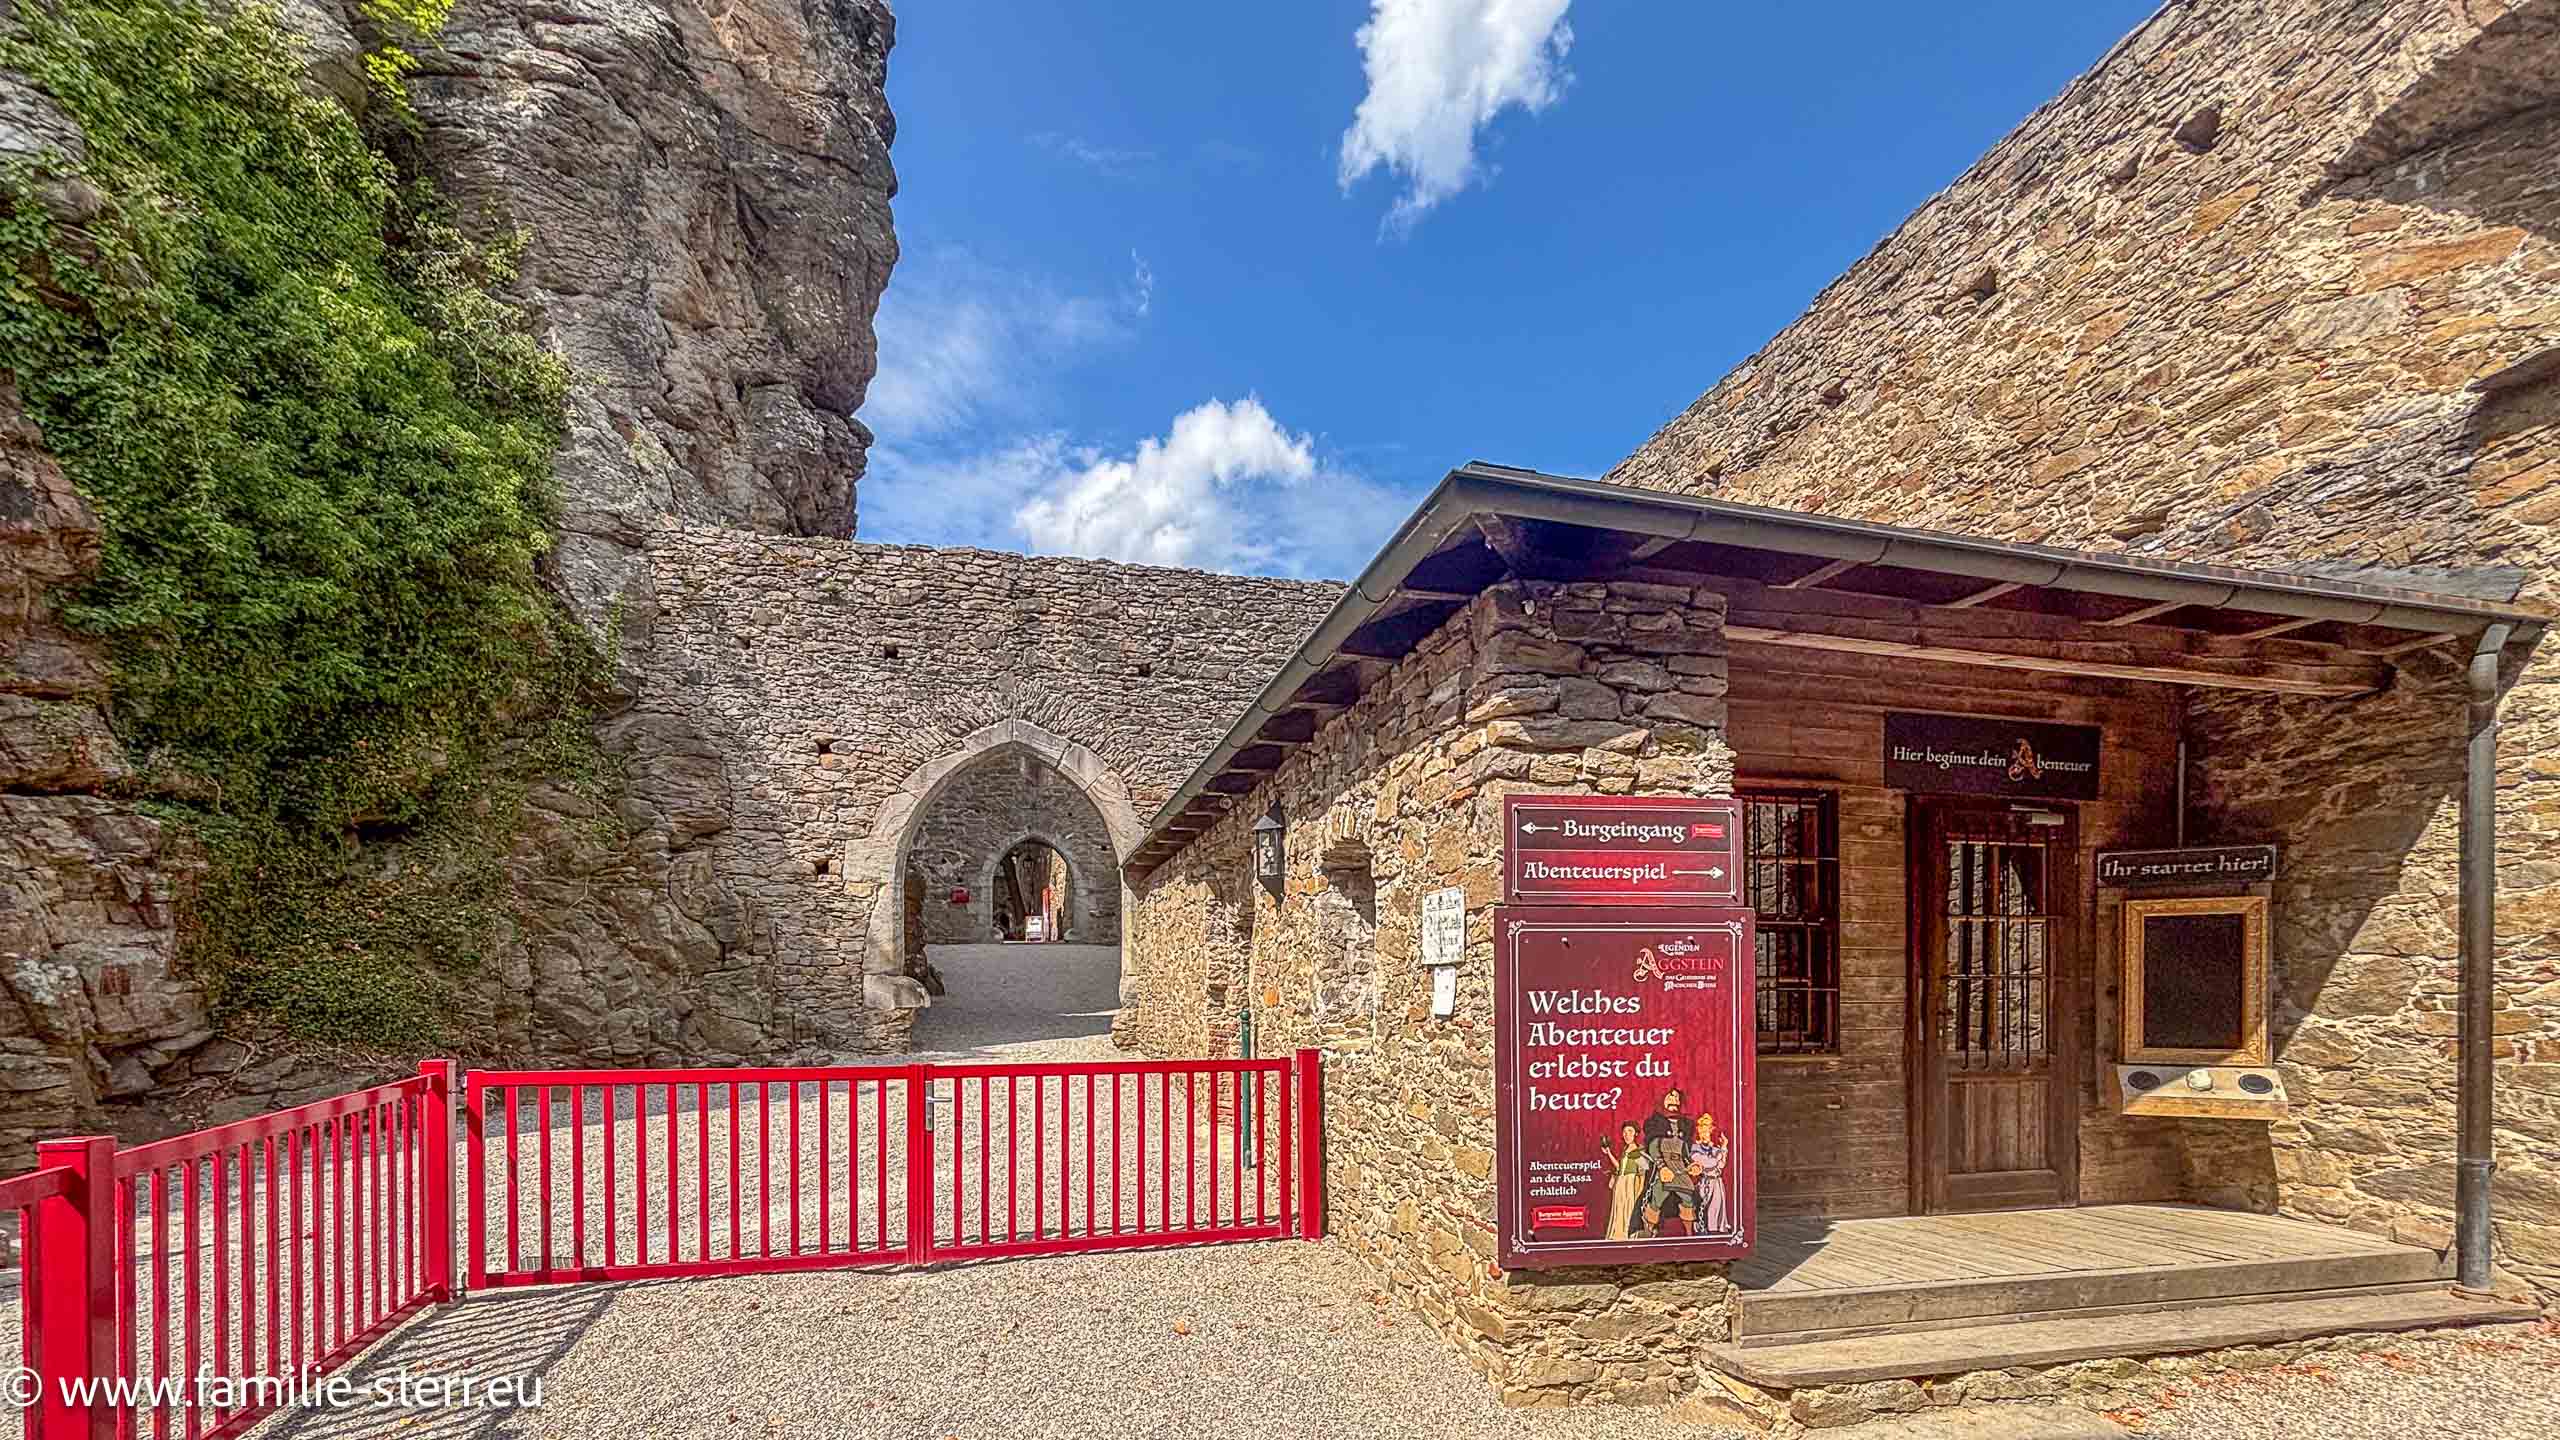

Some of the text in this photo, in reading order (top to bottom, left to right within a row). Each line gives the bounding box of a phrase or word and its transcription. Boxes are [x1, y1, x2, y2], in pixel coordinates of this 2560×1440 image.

[1893, 745, 1924, 762] Hier
[1926, 746, 1976, 769] beginnt
[1979, 750, 2006, 768] dein
[1562, 819, 1686, 843] Burgeingang
[1524, 861, 1667, 884] Abenteuerspiel
[2104, 855, 2268, 877] Ihr startet hier!
[1528, 990, 1641, 1014] Welches
[1528, 1022, 1675, 1046] Abenteuer
[1529, 1053, 1672, 1078] erlebst du
[1530, 1087, 1622, 1111] heute?
[1530, 1160, 1602, 1172] Abenteuerspiel
[1545, 1173, 1561, 1183] der
[1563, 1173, 1592, 1183] Kassa
[1530, 1185, 1577, 1196] erhältlich
